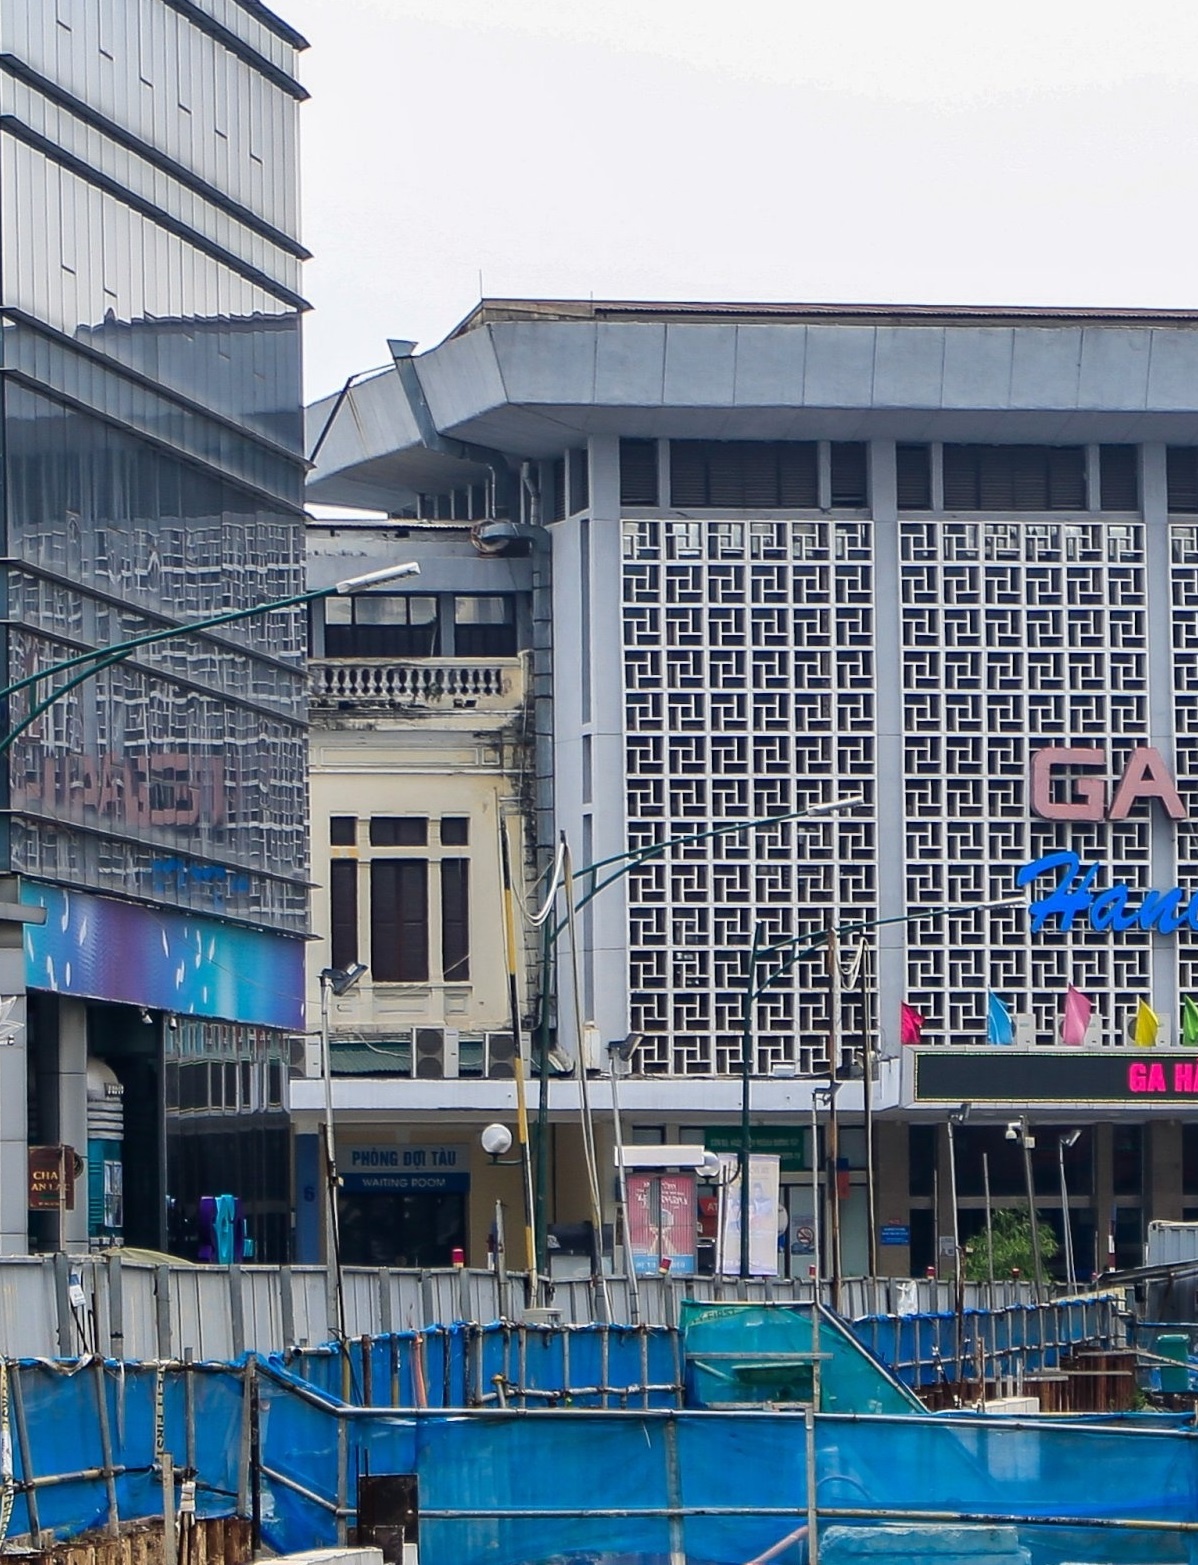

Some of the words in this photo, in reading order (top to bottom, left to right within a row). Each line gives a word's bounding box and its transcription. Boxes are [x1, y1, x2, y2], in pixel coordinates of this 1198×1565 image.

[1030, 747, 1187, 822] GA
[1128, 1062, 1167, 1093] GA
[352, 1147, 398, 1167] PHÒNG
[403, 1149, 427, 1170] ĐỢI
[432, 1147, 457, 1167] TÀU
[362, 1178, 409, 1188] WAITING
[411, 1178, 446, 1188] ROOM
